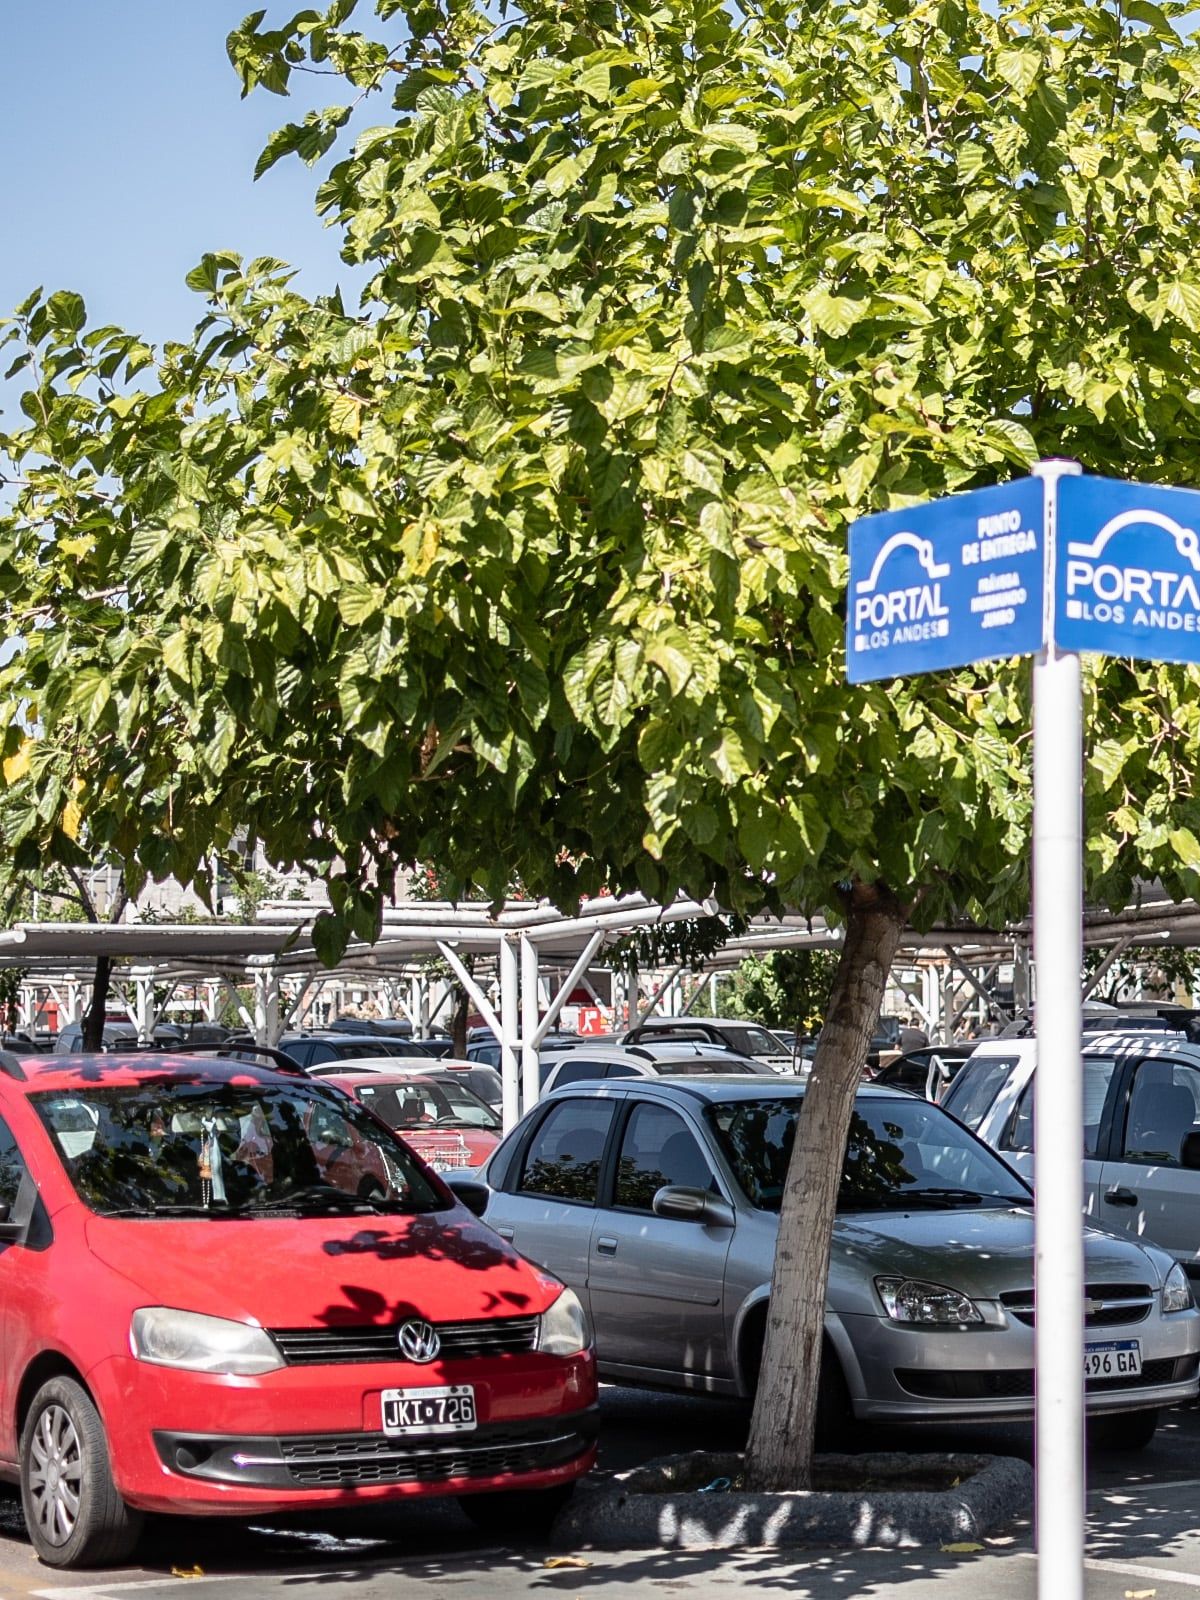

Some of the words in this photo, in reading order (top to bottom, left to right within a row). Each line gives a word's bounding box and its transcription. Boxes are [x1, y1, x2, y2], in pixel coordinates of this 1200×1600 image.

[977, 509, 1022, 539] PUNTO
[962, 541, 980, 566] DE
[980, 529, 1037, 562] ENTREGA
[855, 583, 949, 631] PORTAL
[1083, 602, 1125, 624] LOS
[864, 631, 889, 650] LOS
[893, 625, 939, 645] ANDES
[1117, 1352, 1138, 1373] GA
[387, 1400, 424, 1426] JKI
[435, 1397, 472, 1423] 726
